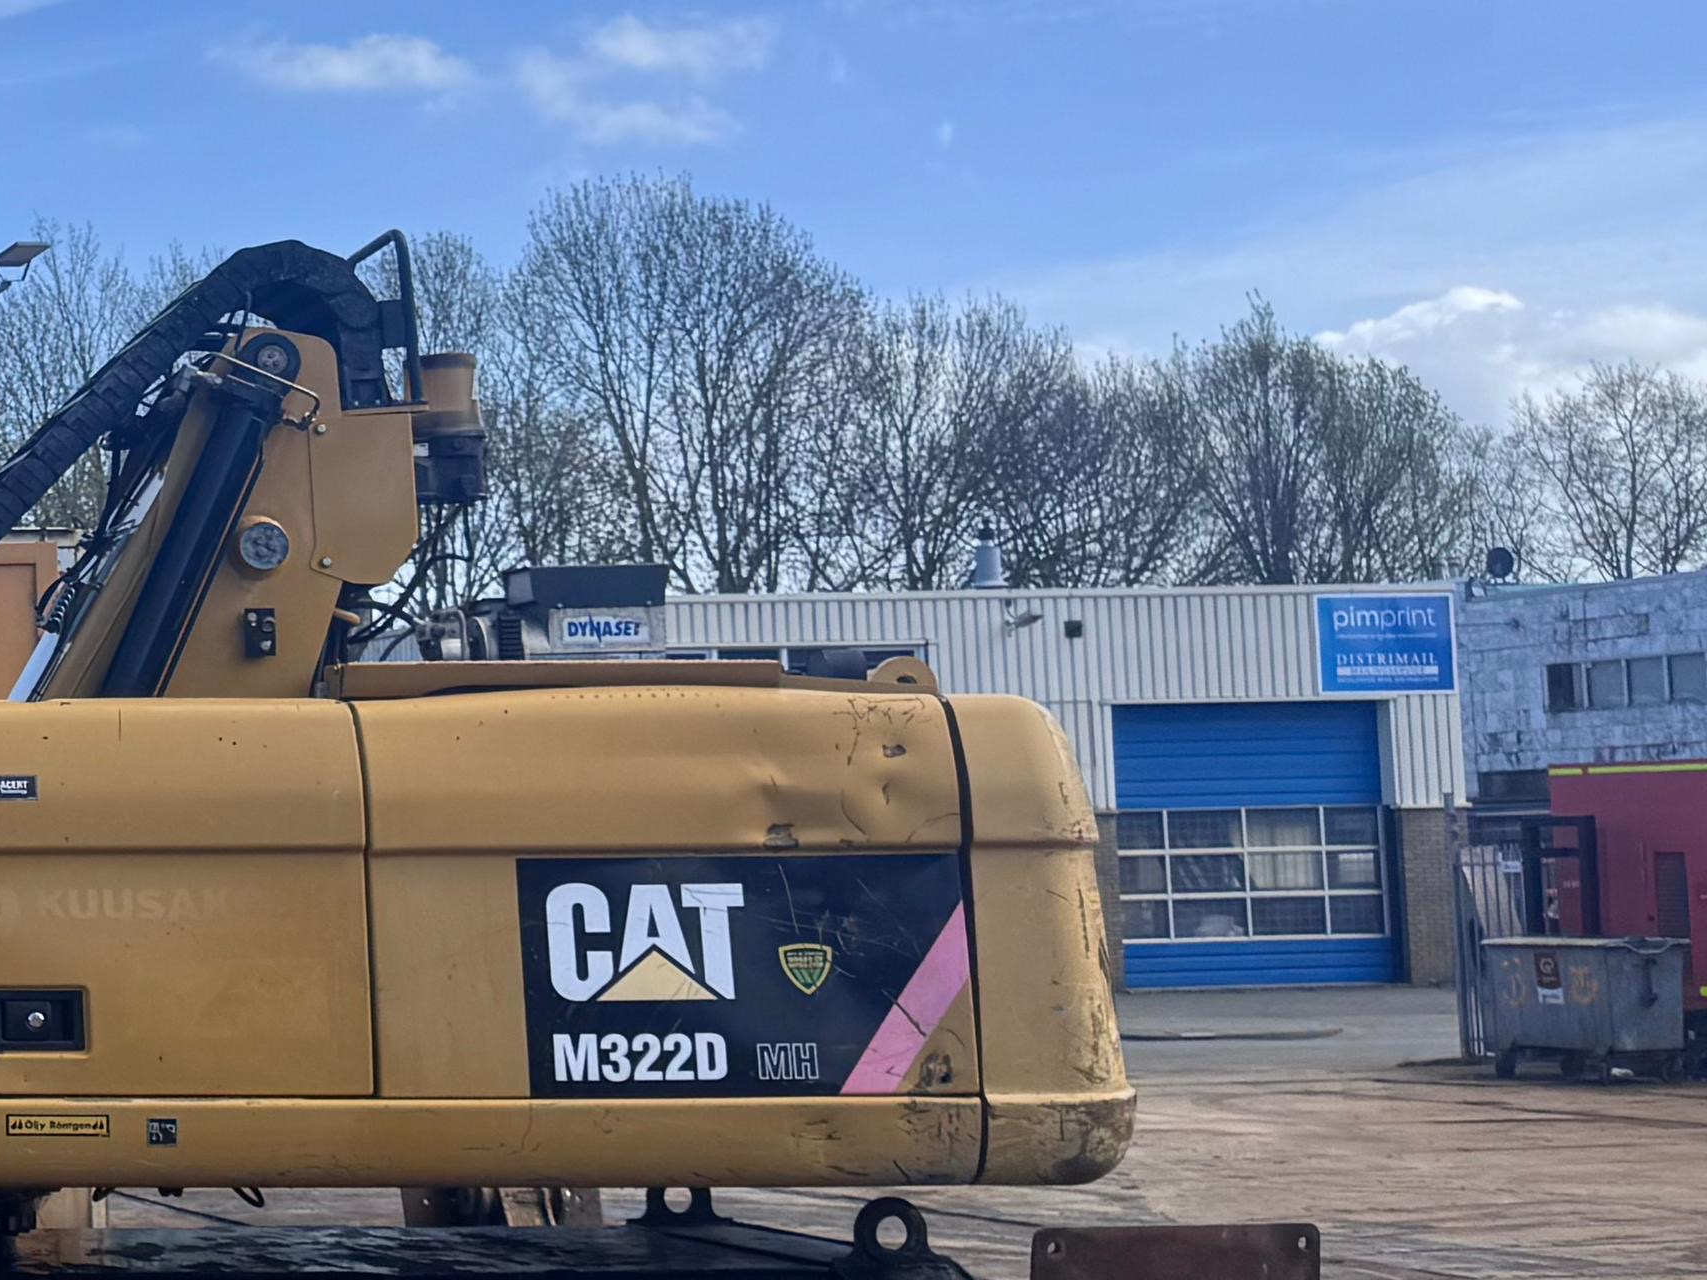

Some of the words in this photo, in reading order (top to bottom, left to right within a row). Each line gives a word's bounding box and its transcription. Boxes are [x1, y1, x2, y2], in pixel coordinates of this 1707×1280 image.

[1332, 605, 1436, 632] pimprint
[1336, 652, 1438, 666] DISTRIMAIL
[545, 882, 745, 1002] CAT
[552, 1032, 728, 1081] M322D
[756, 1042, 819, 1080] MH
